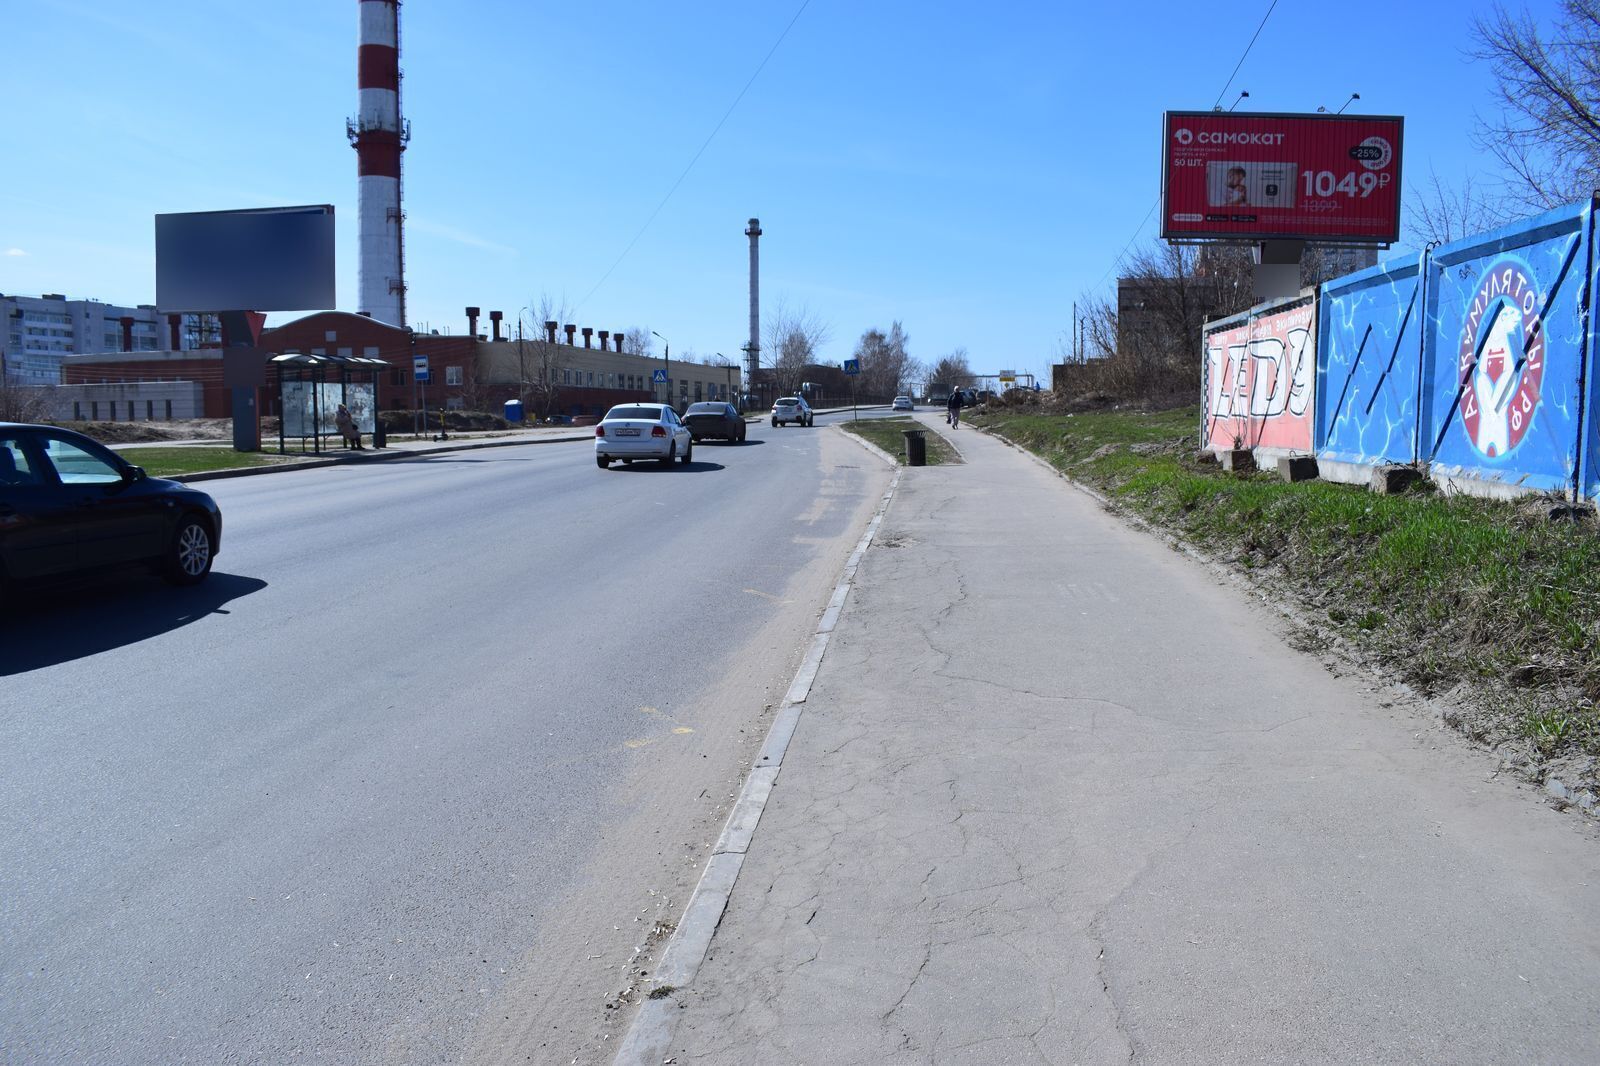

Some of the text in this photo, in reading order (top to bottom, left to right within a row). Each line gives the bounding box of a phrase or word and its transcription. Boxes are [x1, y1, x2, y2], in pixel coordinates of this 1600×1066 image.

[1351, 148, 1380, 158] -25%
[1173, 158, 1204, 167] 50 ШТ.
